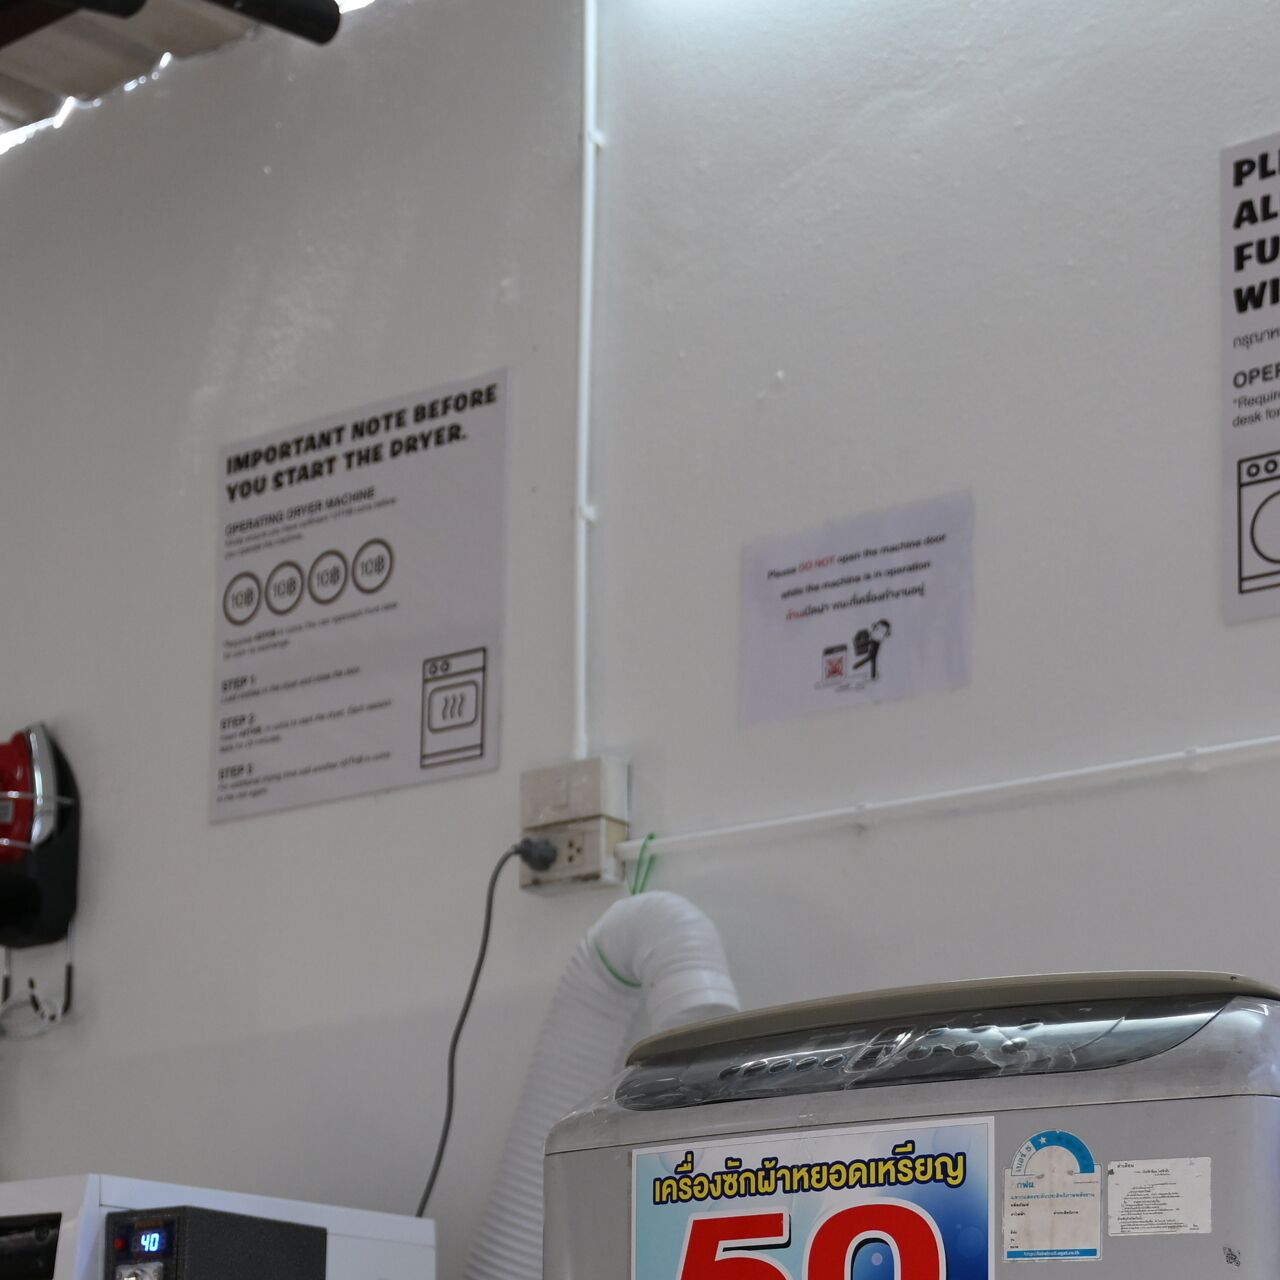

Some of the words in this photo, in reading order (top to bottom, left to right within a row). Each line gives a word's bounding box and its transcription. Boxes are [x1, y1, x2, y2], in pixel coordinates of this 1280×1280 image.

[226, 425, 346, 476] IMPORTANT
[351, 408, 407, 440] NOTE
[413, 383, 497, 423] BEFORE
[1231, 411, 1262, 428] desk
[226, 477, 267, 503] YOU
[272, 456, 337, 490] START
[344, 444, 383, 470] THE
[389, 423, 467, 459] DRYER.
[653, 1140, 966, 1204] เครื่องซักผ้าหยอดเหรียญ
[141, 1233, 160, 1252] 40
